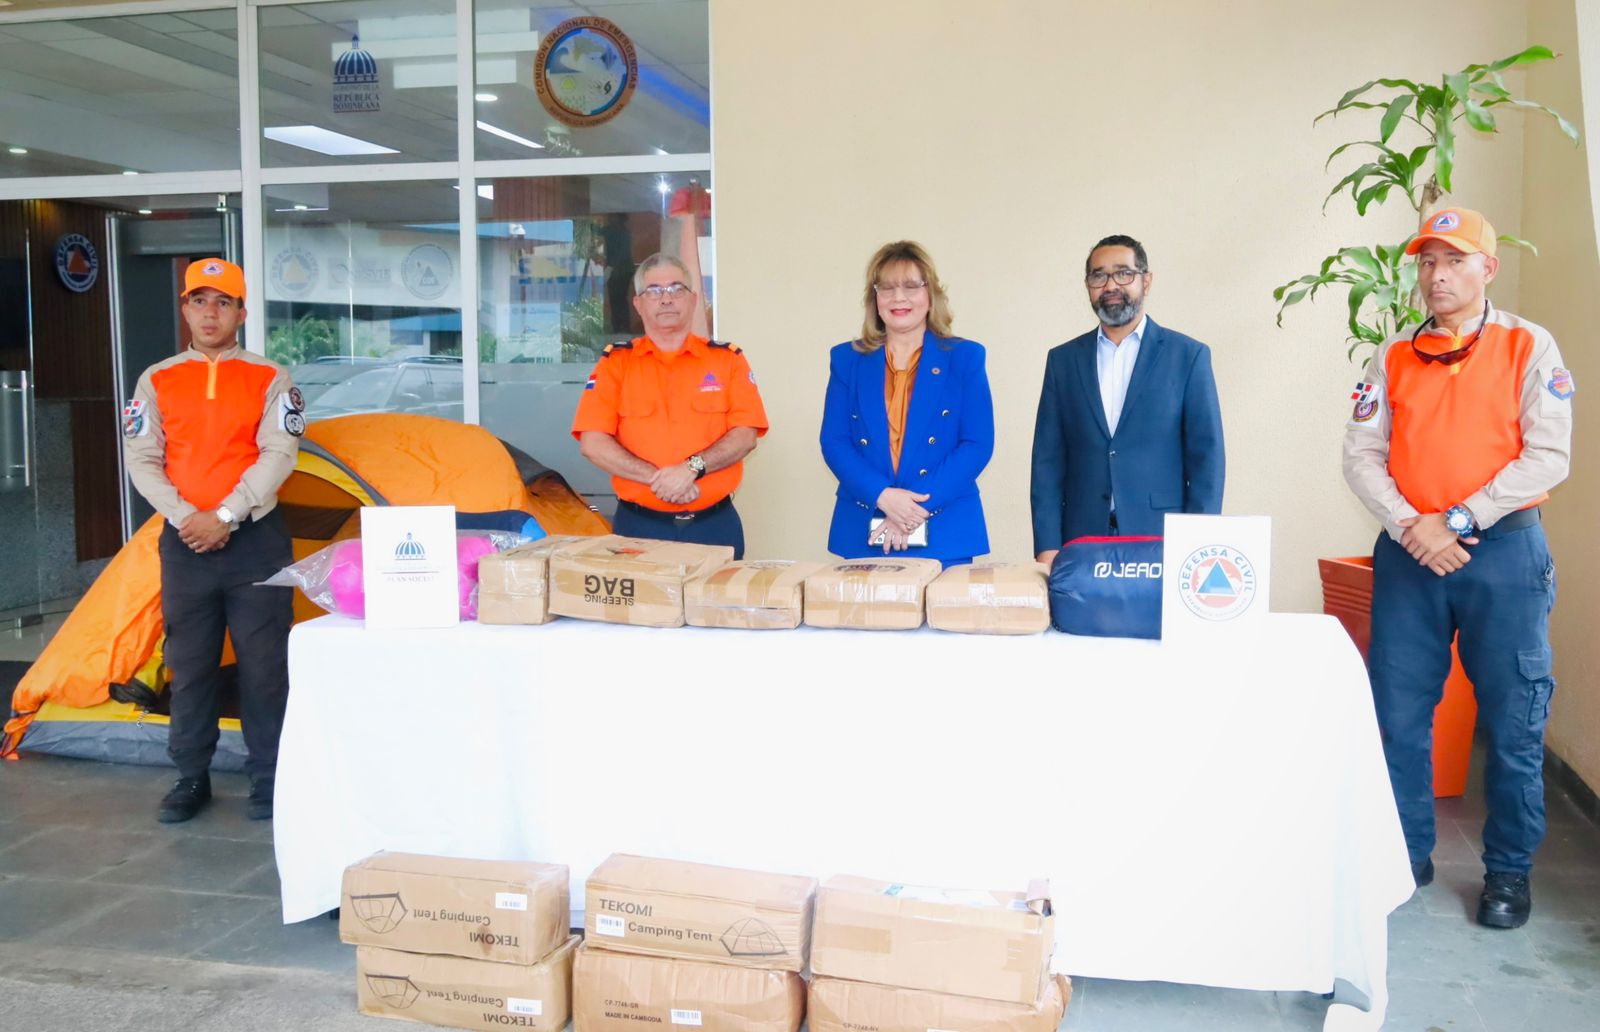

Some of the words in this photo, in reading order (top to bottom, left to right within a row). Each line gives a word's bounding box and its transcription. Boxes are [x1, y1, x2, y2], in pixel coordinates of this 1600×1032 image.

[547, 19, 591, 46] NACIONAL
[594, 18, 605, 29] DE
[607, 24, 637, 90] EMERGENCIAS
[1181, 547, 1229, 590] DEFENSA
[1234, 556, 1253, 591] CIVIL
[584, 574, 635, 597] BAG
[584, 593, 635, 607] SLEEPING
[413, 907, 438, 921] Tent
[599, 898, 653, 917] TEKOMI
[440, 909, 492, 927] Camping
[469, 932, 520, 948] TEKOMI
[628, 921, 684, 941] Camping
[685, 928, 713, 943] Tent
[426, 989, 452, 1000] Tent
[452, 990, 504, 1008] Camping
[483, 1012, 537, 1027] TEKOMI
[604, 1011, 622, 1019] MADE
[631, 1014, 663, 1023] CAMBODIA
